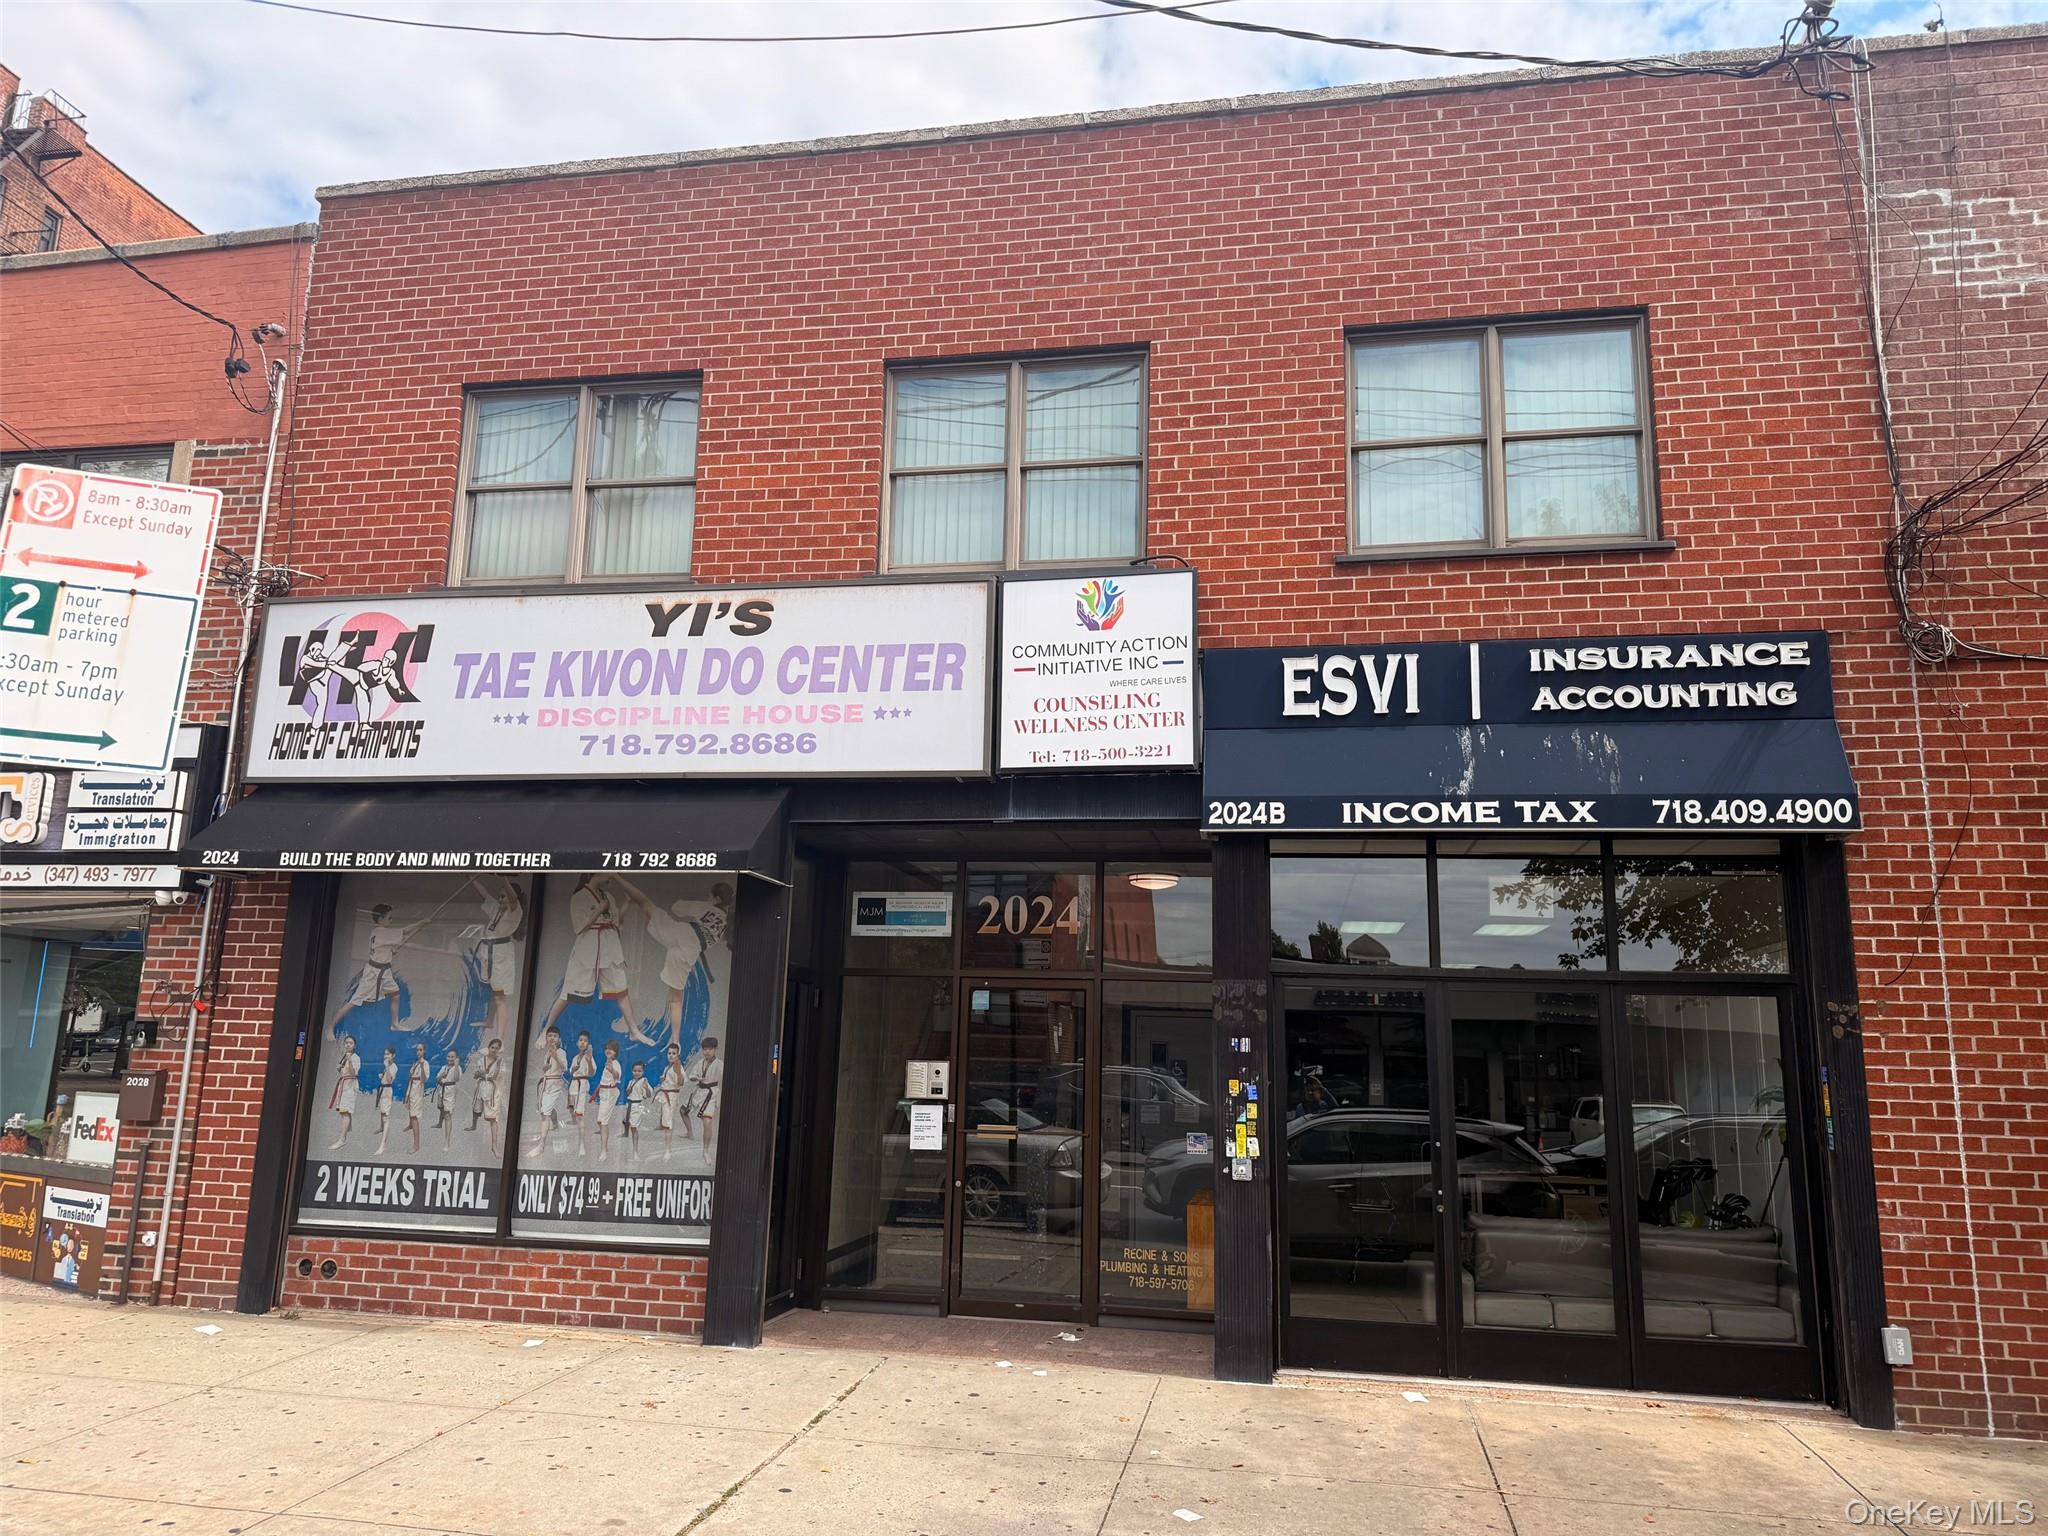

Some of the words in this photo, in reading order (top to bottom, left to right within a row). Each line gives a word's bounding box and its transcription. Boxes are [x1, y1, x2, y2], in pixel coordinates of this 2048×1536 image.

[88, 490, 120, 507] 8am
[136, 494, 192, 516] 8:30am
[83, 510, 134, 531] Except
[139, 517, 193, 539] Sunday
[3, 583, 41, 629] 2
[65, 592, 102, 609] hour
[62, 611, 129, 628] metered
[58, 628, 118, 646] parking
[1012, 640, 1117, 659] COMMUNITY
[1120, 635, 1188, 653] ACTION
[1038, 658, 1124, 676] INITIATIVE
[1129, 655, 1159, 670] INC
[1529, 641, 1811, 672] INSURANCE
[81, 660, 118, 681] 7pm
[453, 652, 536, 699] TAE
[544, 648, 687, 698] KWON
[697, 646, 764, 696] DO
[776, 643, 967, 695] CENTER
[54, 680, 124, 706] Sunday
[1109, 679, 1139, 688] WHERE
[1140, 677, 1163, 686] CARE
[1164, 676, 1187, 685] LIVES
[1281, 654, 1420, 718] ESVI
[1033, 692, 1161, 714] COUNSELING
[1531, 682, 1798, 711] ACCOUNTING
[537, 706, 730, 727] DISCIPLINE
[742, 704, 864, 725] HOUSE
[1014, 715, 1109, 735] WELLNESS
[1113, 711, 1186, 730] CENTER
[579, 732, 818, 756] 718.792.8686
[1029, 750, 1056, 763] Tel:
[1062, 744, 1172, 762] 718-500-3221
[92, 792, 155, 806] Translation
[1208, 801, 1286, 825] 2024B
[1341, 800, 1501, 824] INCOME
[1514, 801, 1599, 823] TAX
[1652, 798, 1853, 824] 718.409.4900
[79, 832, 156, 848] Immigration
[202, 850, 240, 865] 2024
[279, 852, 321, 866] BUILD
[325, 852, 352, 866] THE
[355, 852, 395, 867] BODY
[396, 853, 428, 867] AND
[431, 853, 471, 867] MIND
[474, 852, 551, 867] TOGETHER
[602, 852, 632, 867] 718
[638, 852, 669, 867] 792
[675, 852, 717, 867] 8686
[44, 865, 79, 885] (347)
[83, 866, 110, 882] 493
[122, 867, 158, 883] 7977
[859, 907, 884, 916] MJM
[976, 895, 1081, 935] 2024
[127, 1077, 150, 1086] 2028
[74, 1115, 115, 1142] FedEx
[314, 1165, 330, 1202] 2
[336, 1166, 416, 1206] WEEKS
[422, 1170, 490, 1209] TRIAL
[518, 1176, 556, 1213] ONLY
[614, 1178, 653, 1217] FREE
[656, 1178, 714, 1220] UNIFOR
[57, 1206, 95, 1223] Translation
[1123, 1247, 1157, 1261] RECINE
[1161, 1251, 1168, 1261] &
[1173, 1252, 1200, 1263] SONS
[1100, 1261, 1147, 1273] PLUMBING
[1152, 1264, 1159, 1274] &
[1164, 1265, 1203, 1277] HEATING
[1129, 1276, 1194, 1290] 718-597-5706
